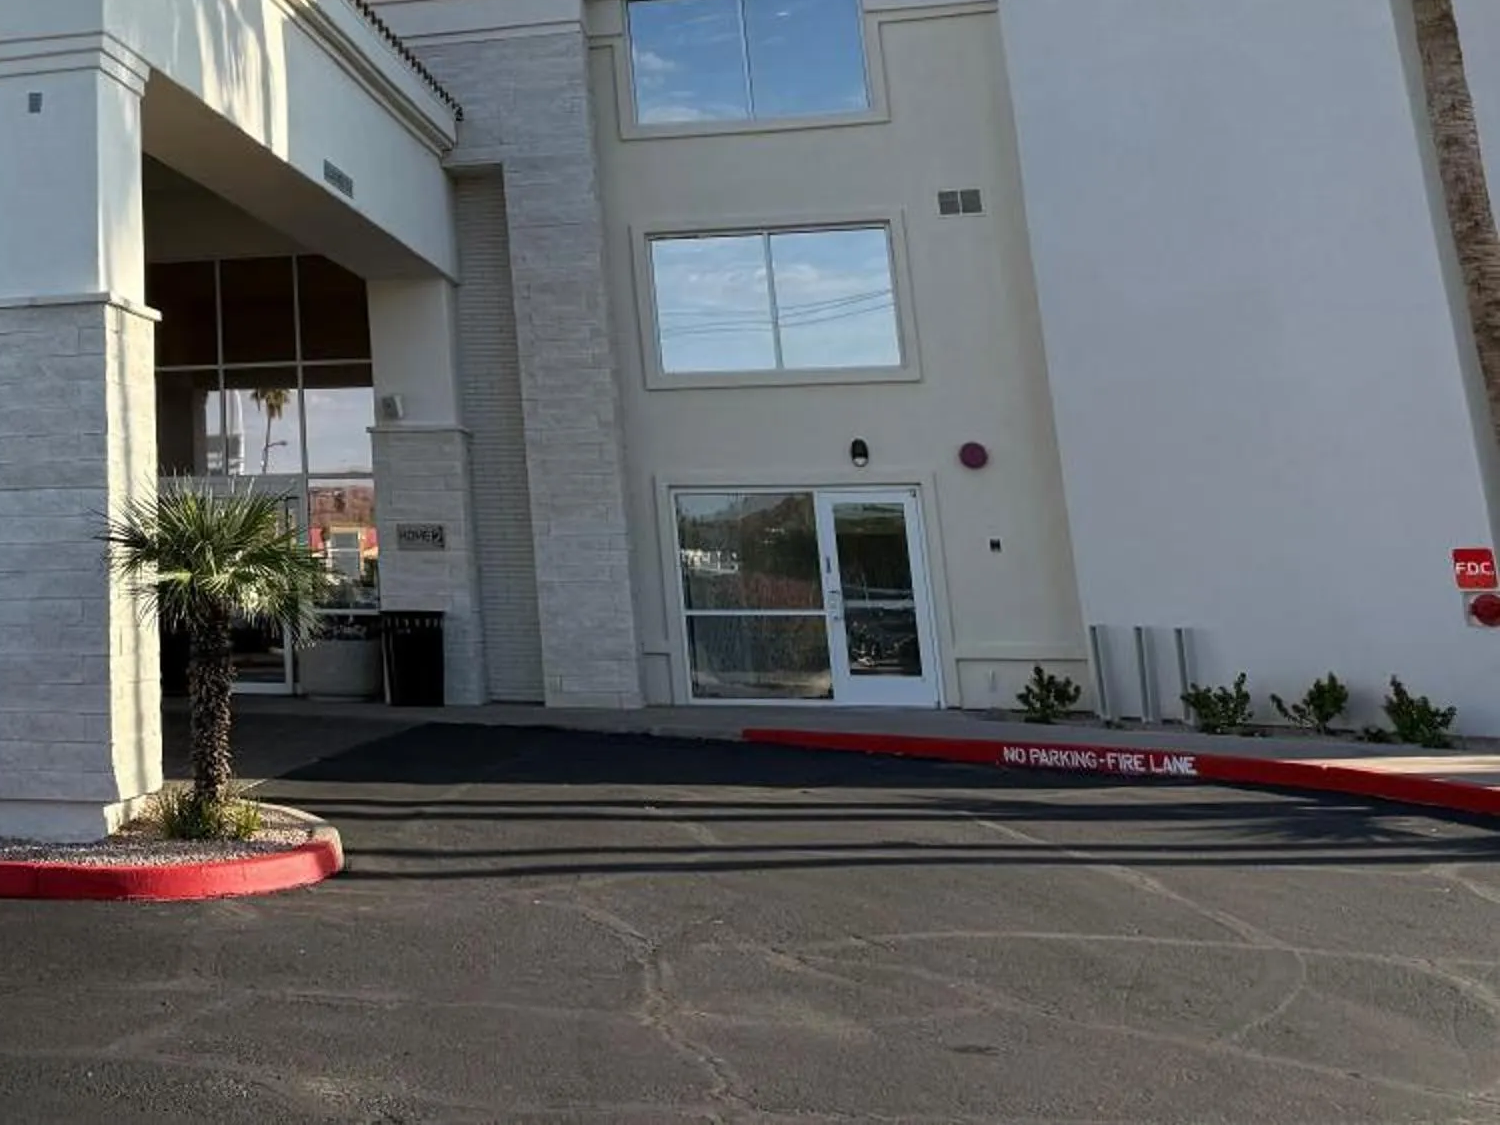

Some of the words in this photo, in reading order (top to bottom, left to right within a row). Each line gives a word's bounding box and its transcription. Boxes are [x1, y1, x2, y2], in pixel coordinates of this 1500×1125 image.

[1455, 561, 1492, 576] FDC
[1003, 746, 1027, 764] NO
[1149, 754, 1198, 775] LANE
